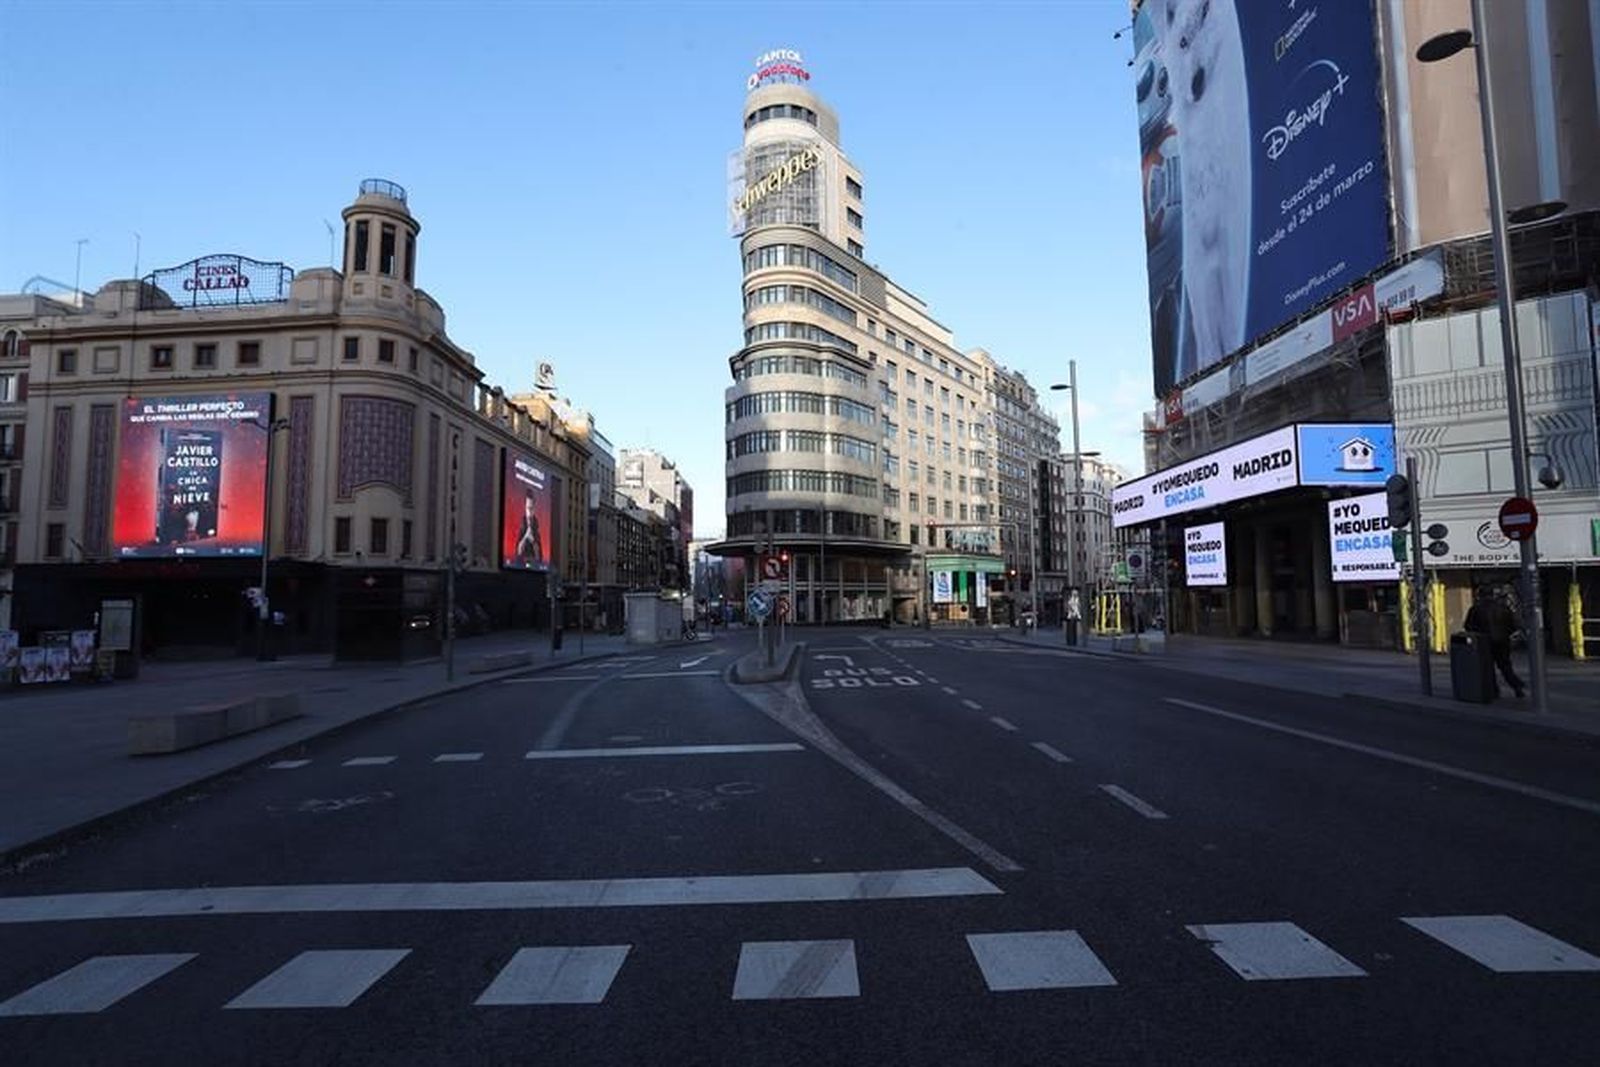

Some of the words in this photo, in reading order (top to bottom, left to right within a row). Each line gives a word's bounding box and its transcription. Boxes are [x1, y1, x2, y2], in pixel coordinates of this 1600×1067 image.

[756, 48, 804, 68] CAPITOL
[757, 63, 811, 81] vodafone
[1257, 228, 1286, 256] desde
[1287, 214, 1298, 233] el
[1298, 203, 1313, 225] 24
[1315, 192, 1331, 211] de
[1333, 160, 1374, 198] marzo
[198, 264, 238, 277] CINES
[183, 275, 250, 291] CALLAO
[1333, 293, 1373, 327] VSA
[143, 405, 155, 414] EL
[157, 403, 198, 413] THRILLER
[199, 401, 245, 411] PERFECTO
[130, 415, 145, 423] QUE
[146, 414, 172, 422] CAMBIA
[174, 413, 187, 421] LAS
[175, 445, 213, 456] JAVIER
[167, 456, 219, 467] CASTILLO
[1233, 449, 1293, 481] MADRID
[177, 478, 208, 486] CHICA
[1152, 462, 1220, 495] #YOMEQUEDO
[173, 493, 211, 505] NIEVE
[1164, 486, 1206, 508] ENCASA
[1114, 495, 1145, 514] MADRID
[1334, 503, 1361, 518] #YO
[1188, 540, 1222, 554] MEQUEDO
[1335, 535, 1393, 552] ENCASA
[1453, 554, 1474, 562] THE
[1479, 553, 1508, 562] BODY
[1510, 552, 1544, 561] SP
[1342, 562, 1396, 572] RESPONSABLE
[824, 667, 894, 677] BUS
[811, 676, 923, 689] SOLO
